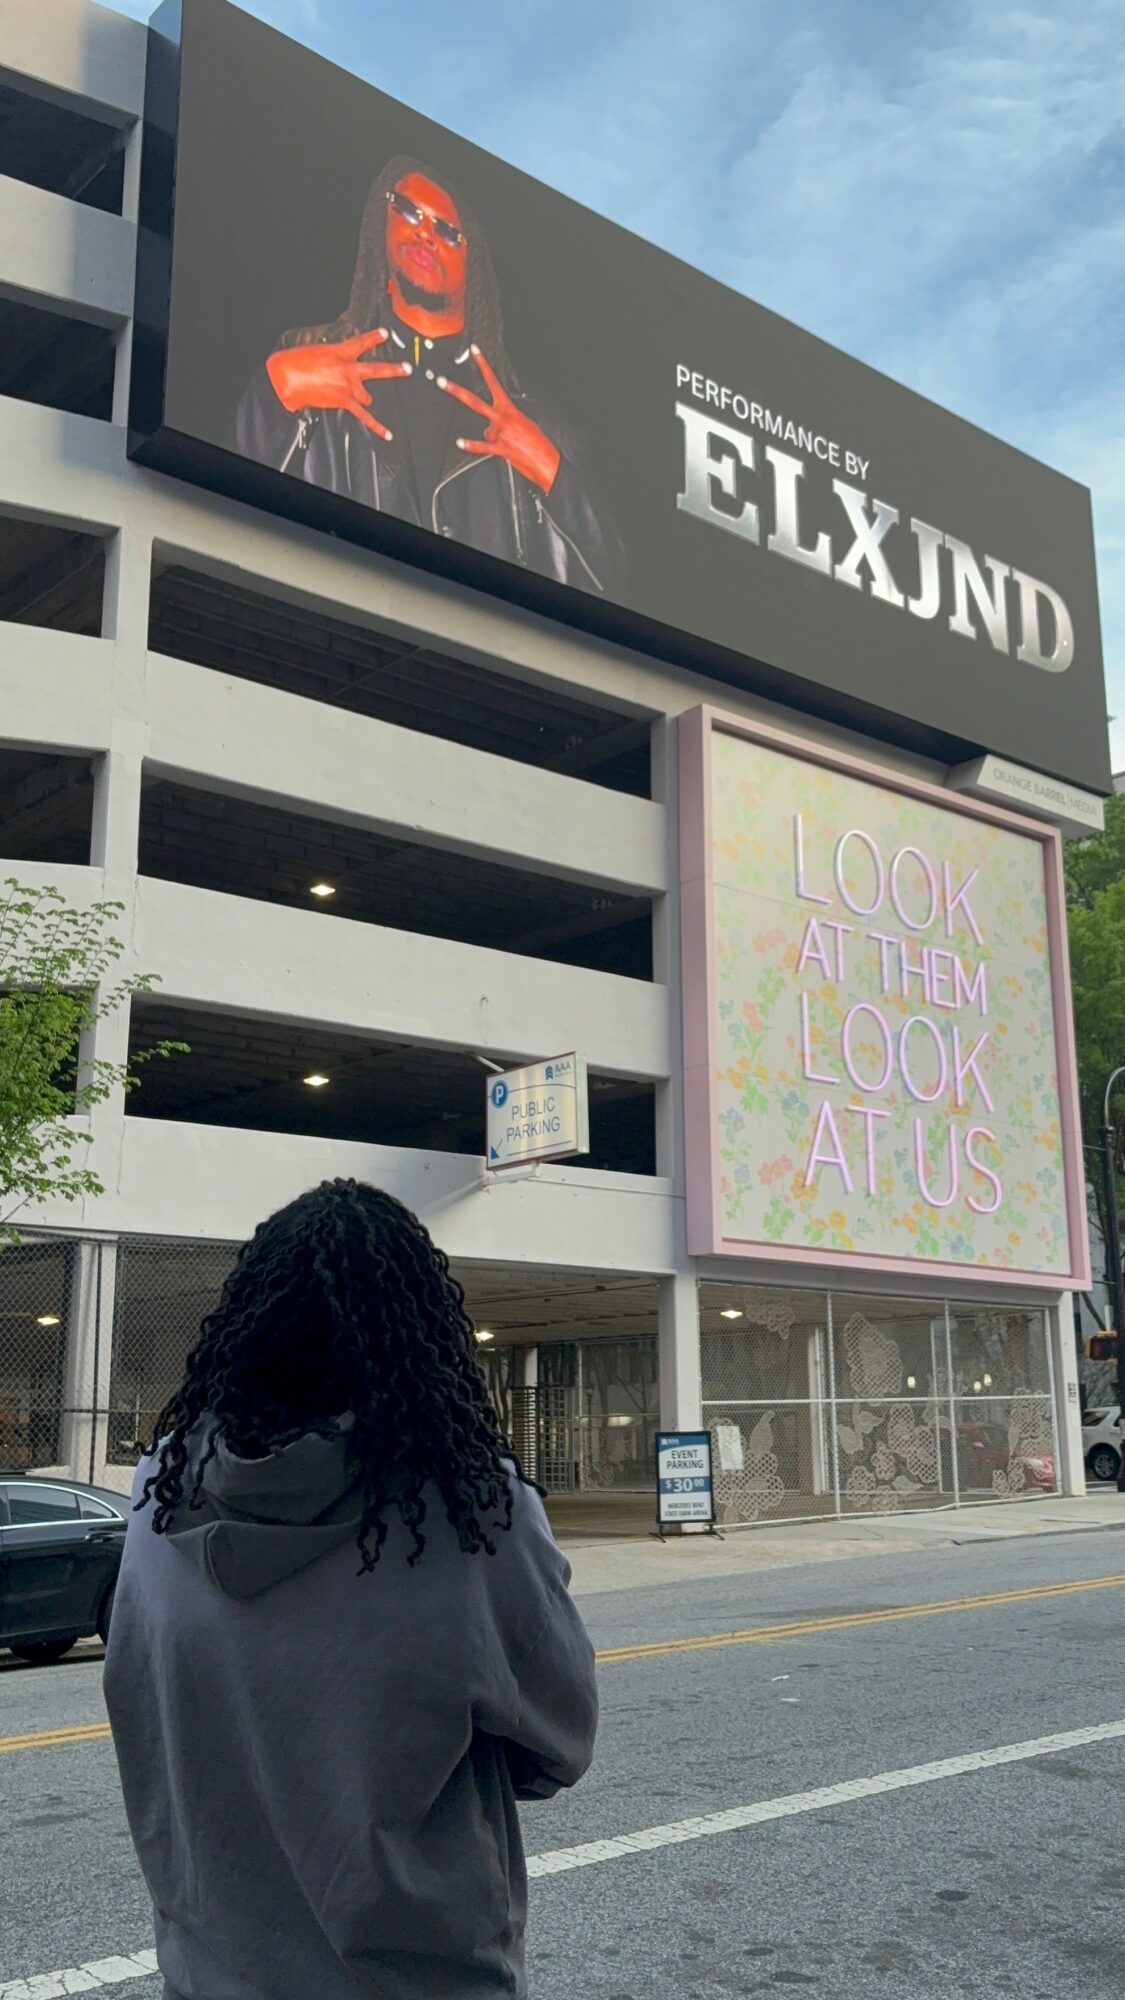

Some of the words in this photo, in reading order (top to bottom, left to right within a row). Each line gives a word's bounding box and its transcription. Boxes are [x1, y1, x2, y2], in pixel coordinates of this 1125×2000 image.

[676, 364, 840, 467] PERFORMANCE
[845, 453, 870, 481] BY
[675, 401, 1075, 674] ELXJND
[993, 767, 1032, 793] ORANGE
[1034, 783, 1067, 805] BARREL
[1070, 798, 1097, 817] MEDIA
[793, 812, 985, 946] LOOK
[796, 917, 854, 983] AT
[868, 932, 987, 1017] THEM
[554, 1061, 571, 1073] AAA
[799, 991, 995, 1114] LOOK
[495, 1085, 504, 1104] P
[511, 1096, 556, 1120] PUBLIC
[506, 1116, 561, 1142] PARKING
[803, 1100, 893, 1195] AT
[912, 1116, 1004, 1216] US
[666, 1460, 704, 1470] PARKING
[671, 1449, 698, 1459] EVENT
